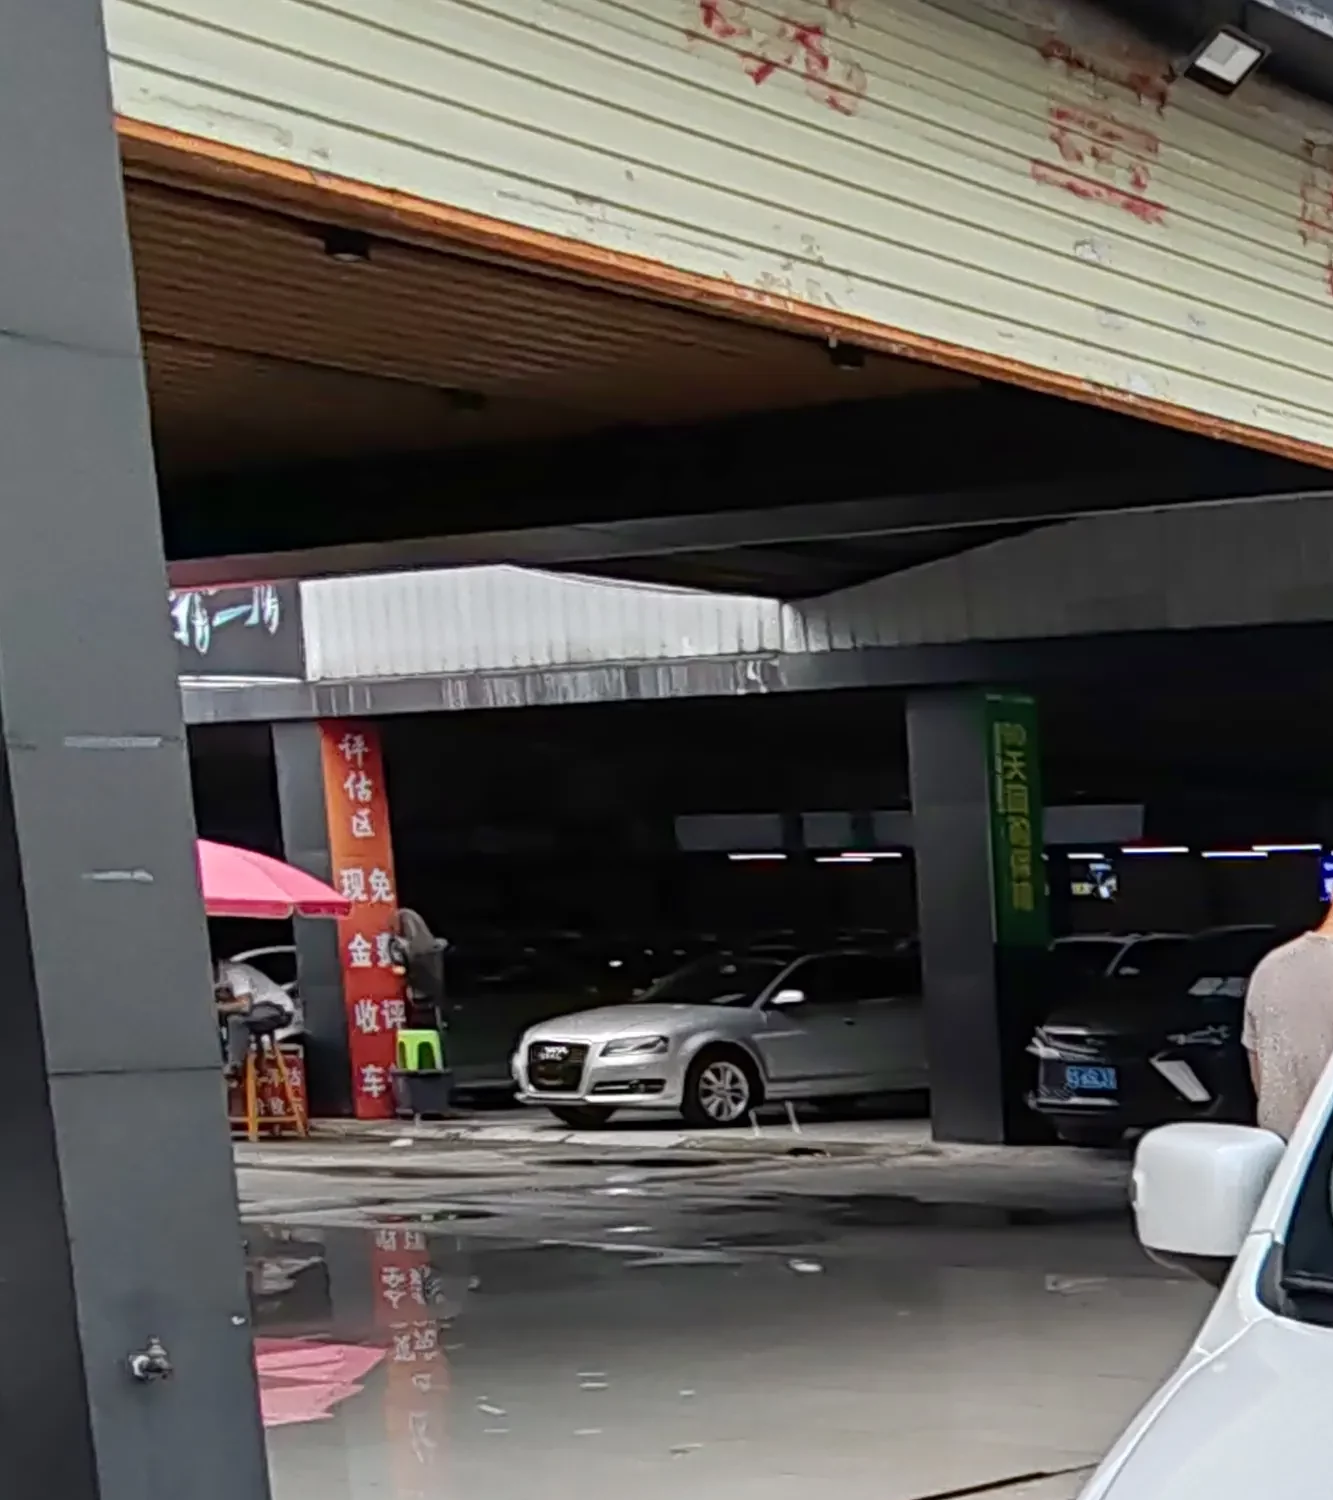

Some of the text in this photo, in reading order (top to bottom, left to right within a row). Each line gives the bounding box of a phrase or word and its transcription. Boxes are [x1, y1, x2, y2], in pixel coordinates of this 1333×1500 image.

[338, 733, 376, 838] 评估区
[339, 867, 386, 1098] 现金收车
